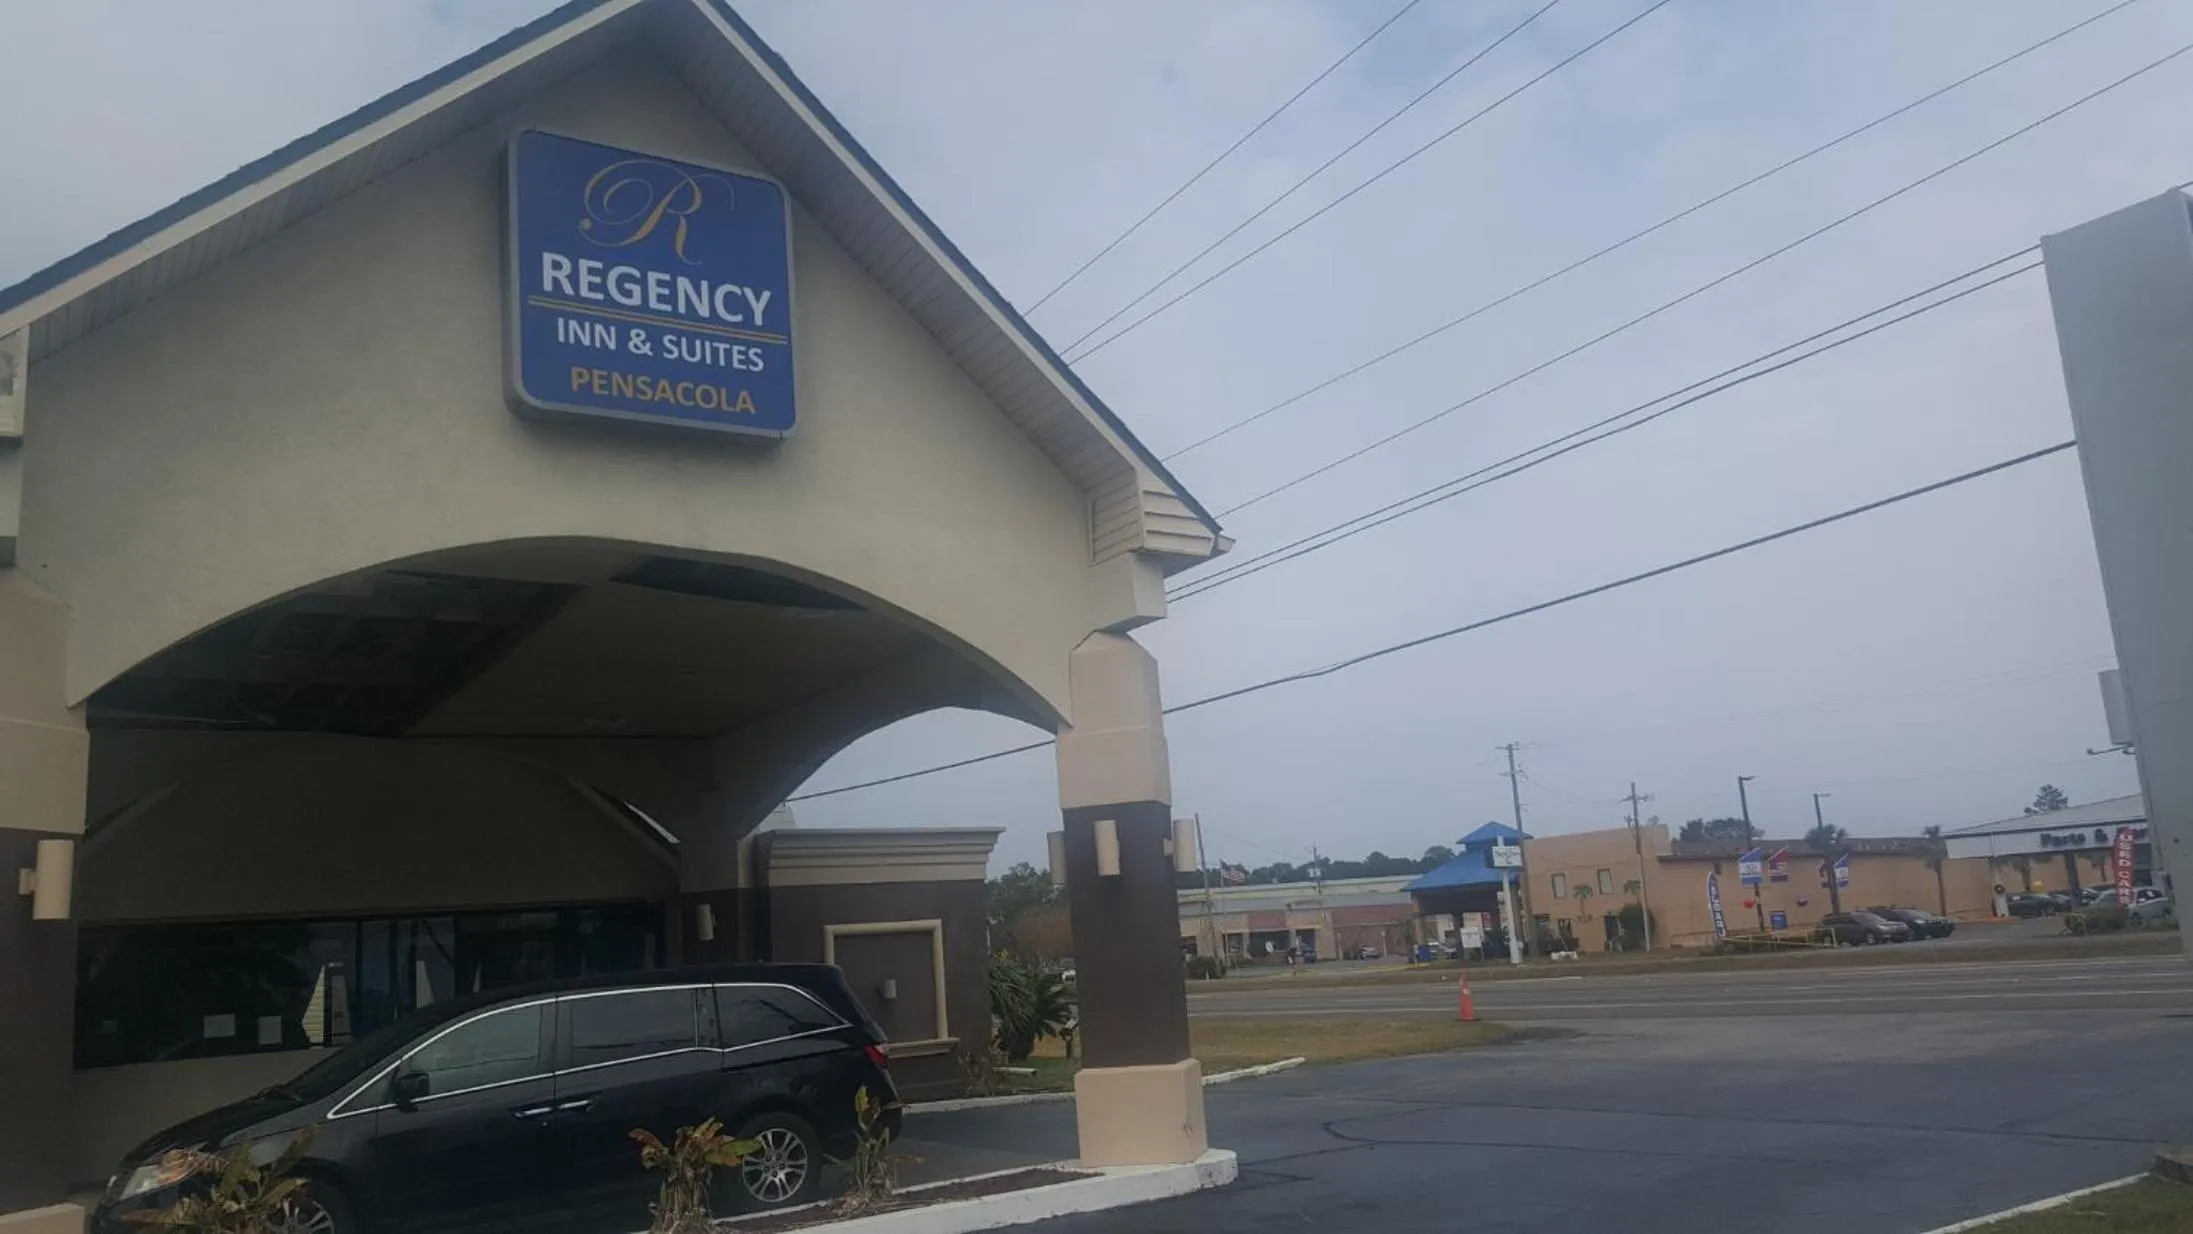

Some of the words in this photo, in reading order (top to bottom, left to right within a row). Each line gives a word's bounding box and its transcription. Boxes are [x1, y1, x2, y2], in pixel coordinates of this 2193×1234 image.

[541, 252, 772, 327] REGENCY
[557, 317, 617, 350] INN
[628, 328, 653, 357] &
[662, 334, 765, 373] SUITES
[570, 366, 756, 415] PENSACOLA
